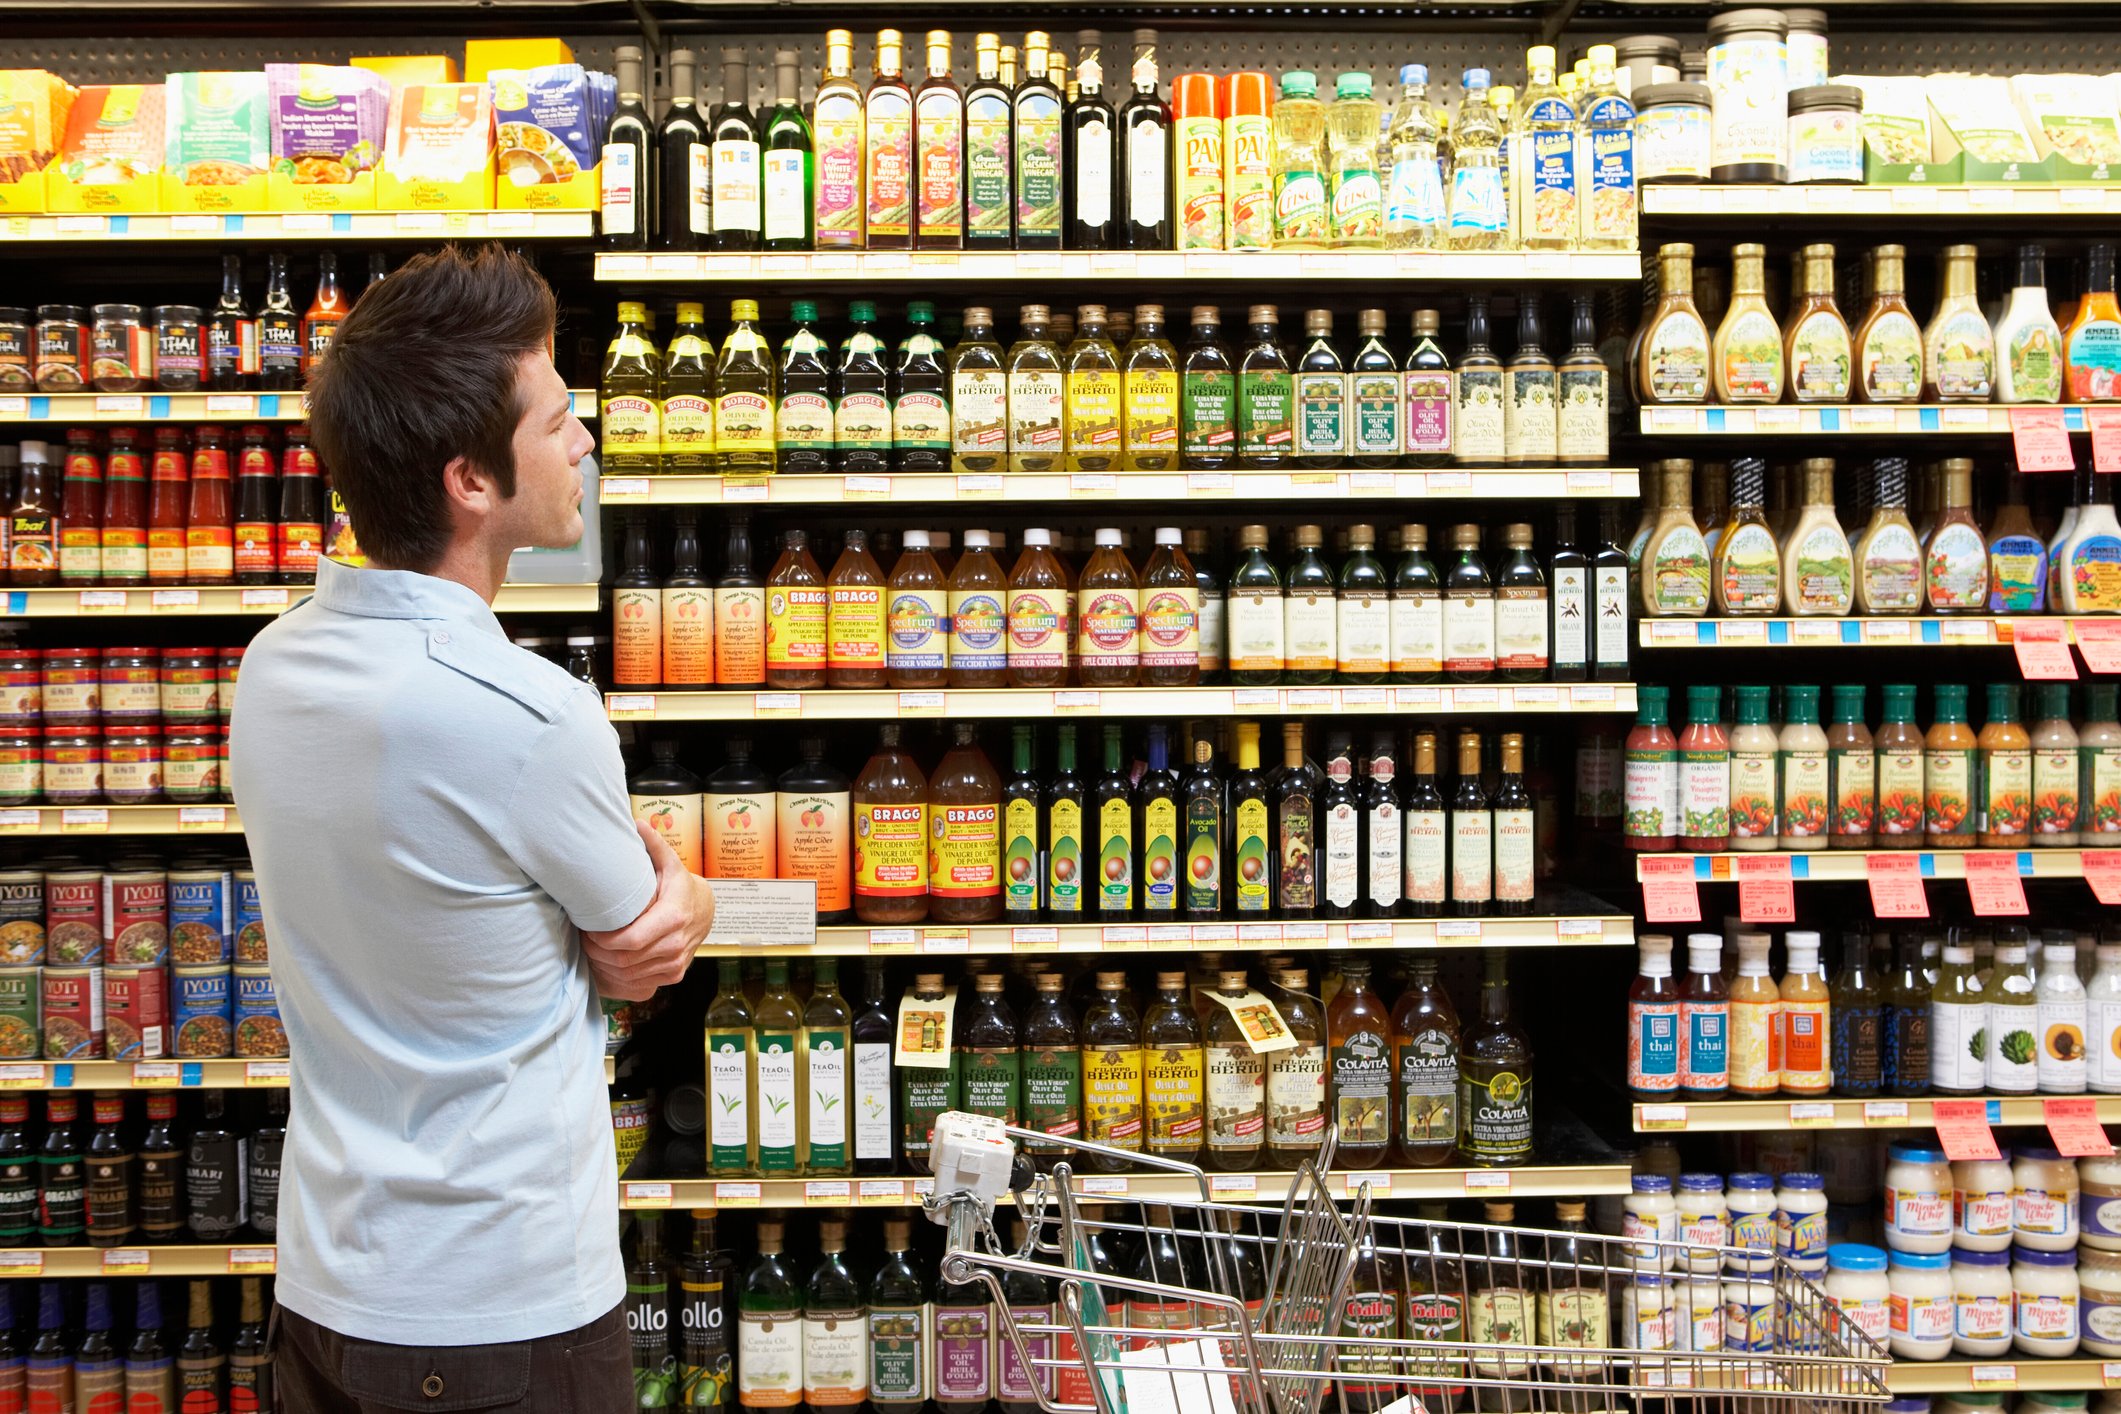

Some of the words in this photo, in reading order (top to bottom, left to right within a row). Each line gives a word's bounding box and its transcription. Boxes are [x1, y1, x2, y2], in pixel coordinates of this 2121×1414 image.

[265, 328, 295, 342] THAI
[158, 336, 196, 353] THAI
[957, 387, 1002, 395] BERIO
[1013, 387, 1058, 395] BERIO
[608, 399, 648, 414] BORGES
[667, 399, 706, 413] BORGES
[724, 397, 763, 410] BORGES
[783, 396, 823, 410] BORGES
[841, 396, 882, 410] BORGES
[898, 396, 939, 410] BORGES
[334, 513, 350, 523] Plu
[835, 592, 877, 601] BRAGG
[1506, 588, 1538, 597] Spectrum
[956, 618, 1003, 627] Spectrum
[1010, 615, 1056, 628] Spectrum
[1087, 617, 1135, 628] Spectrum
[1145, 615, 1193, 626] Spectrum
[1097, 658, 1117, 666] CIDER
[1153, 658, 1174, 666] CIDER
[874, 809, 920, 821] BRAGG
[948, 809, 994, 821] BRAGG
[1198, 825, 1209, 833] Oil
[1762, 906, 1787, 915] $3.49
[184, 979, 226, 994] JYOTi
[1649, 1039, 1672, 1051] thai
[1698, 1038, 1721, 1050] thai
[1336, 1057, 1389, 1070] COLAVITA
[1405, 1055, 1456, 1068] COLAVITA
[1211, 1064, 1263, 1074] BERIO
[1273, 1063, 1325, 1073] BERIO
[1087, 1071, 1138, 1080] BERIO
[1148, 1070, 1199, 1078] BERIO
[1094, 1081, 1114, 1091] OLIVE
[1116, 1081, 1130, 1091] OIL
[1155, 1080, 1175, 1089] OLIVE
[1177, 1080, 1190, 1089] OIL
[1088, 1094, 1109, 1103] HUILE
[1479, 1106, 1528, 1119] COLAVITA
[615, 1114, 649, 1128] BRAG
[774, 1337, 786, 1346] Oil
